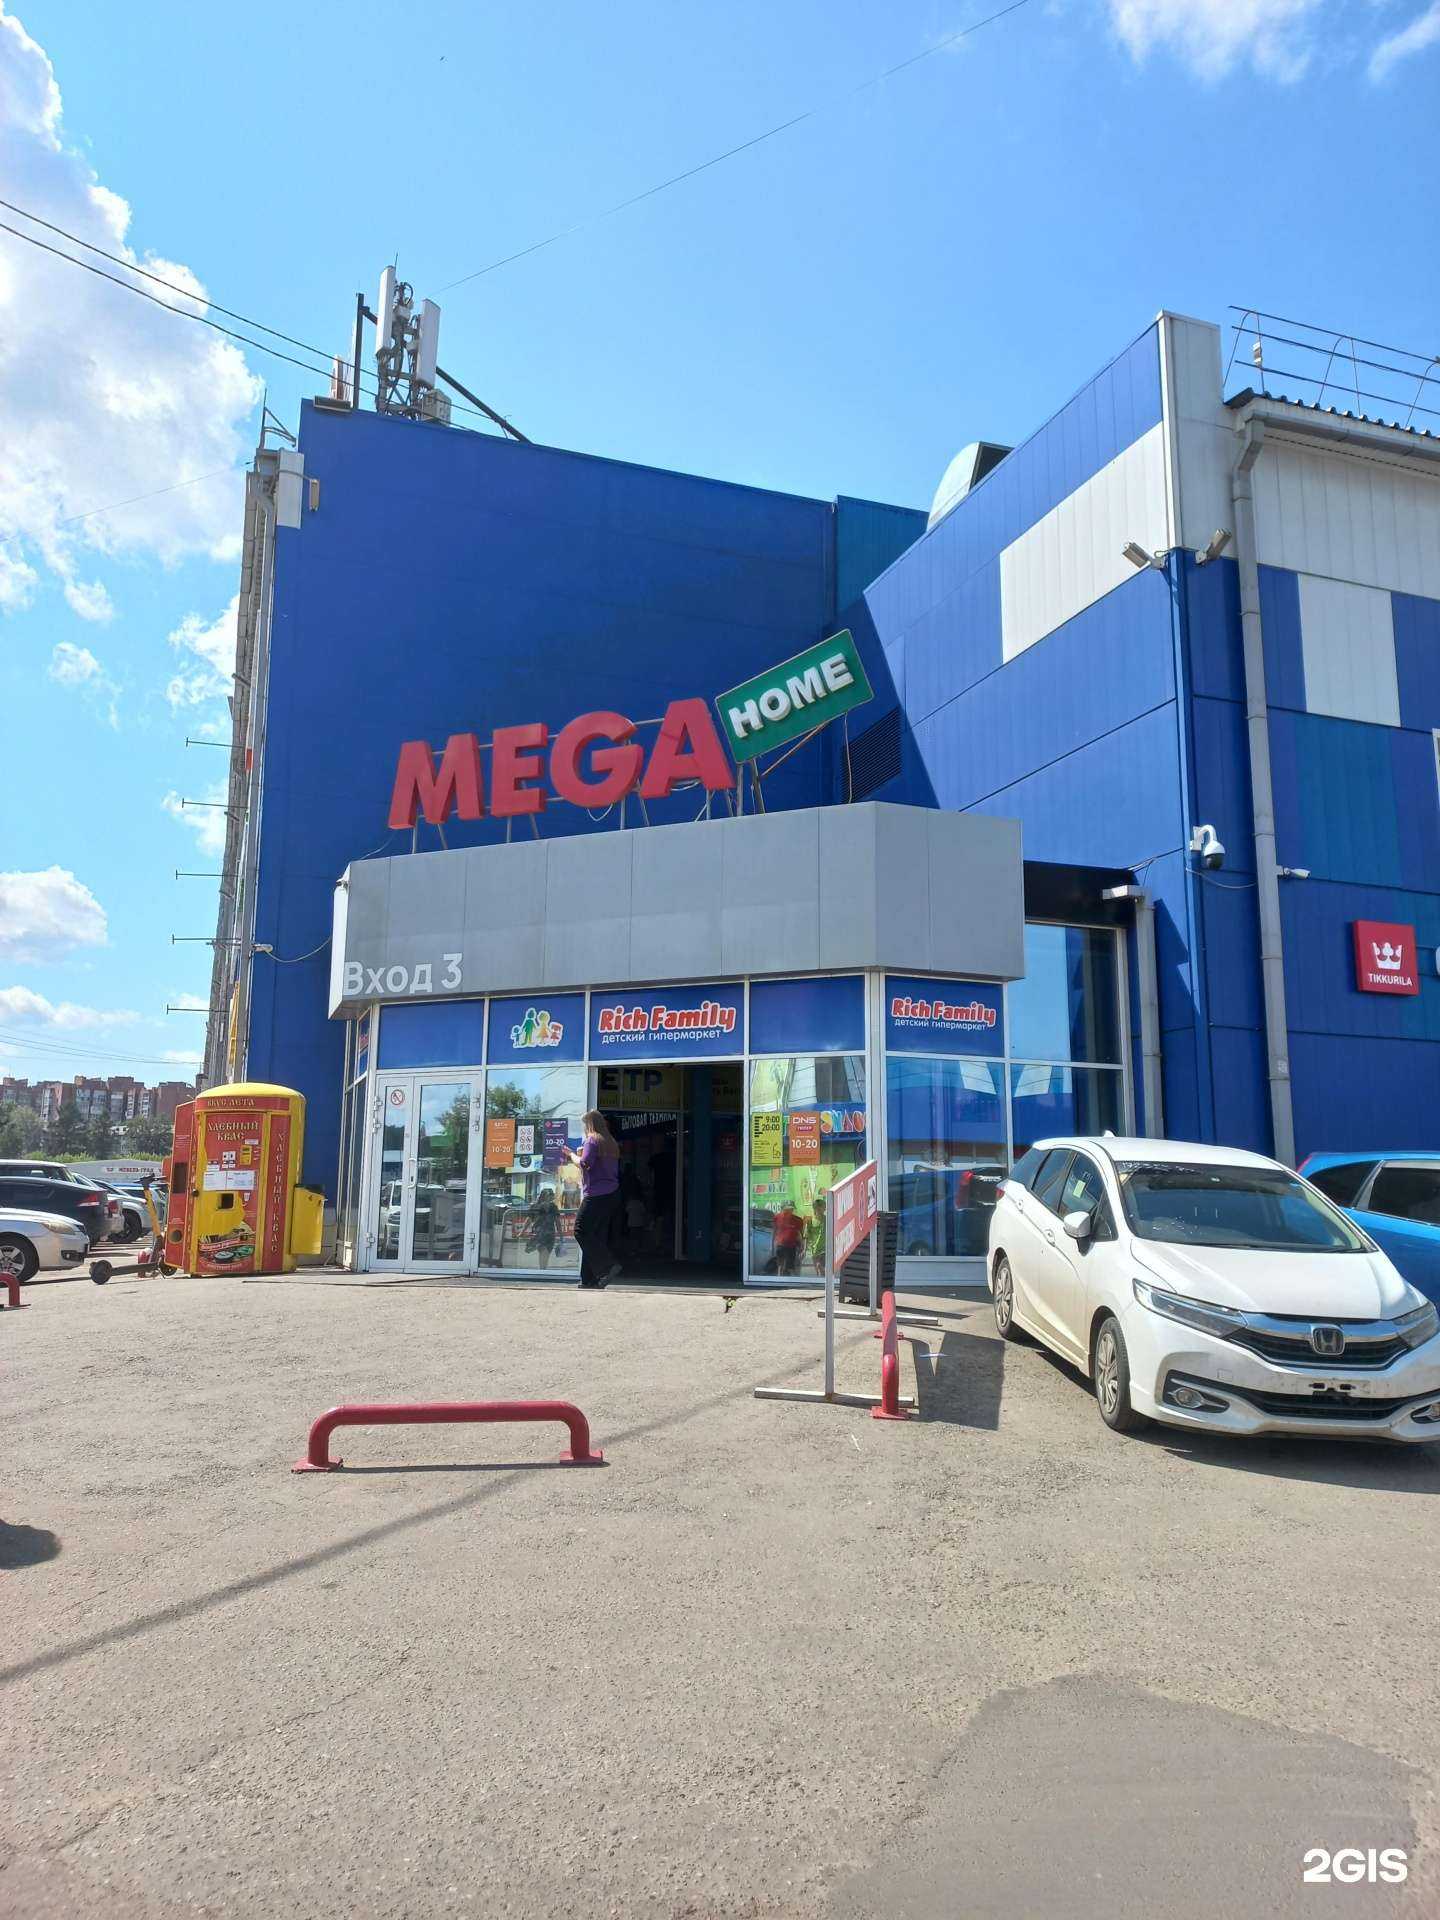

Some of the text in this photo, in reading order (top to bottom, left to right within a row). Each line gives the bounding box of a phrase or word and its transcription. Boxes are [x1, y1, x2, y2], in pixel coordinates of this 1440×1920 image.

[728, 653, 856, 739] HOME
[388, 697, 736, 830] MEGA
[343, 952, 463, 996] Вход 3
[1368, 973, 1413, 986] TIKKURILA
[599, 1000, 736, 1032] Rich Family
[892, 998, 996, 1027] Rich Family
[894, 1018, 986, 1031] детский гипермаркет
[601, 1030, 721, 1044] детский гипермаркет
[792, 1116, 817, 1124] DNS
[545, 1138, 565, 1146] 10-20
[791, 1139, 818, 1148] 10-20
